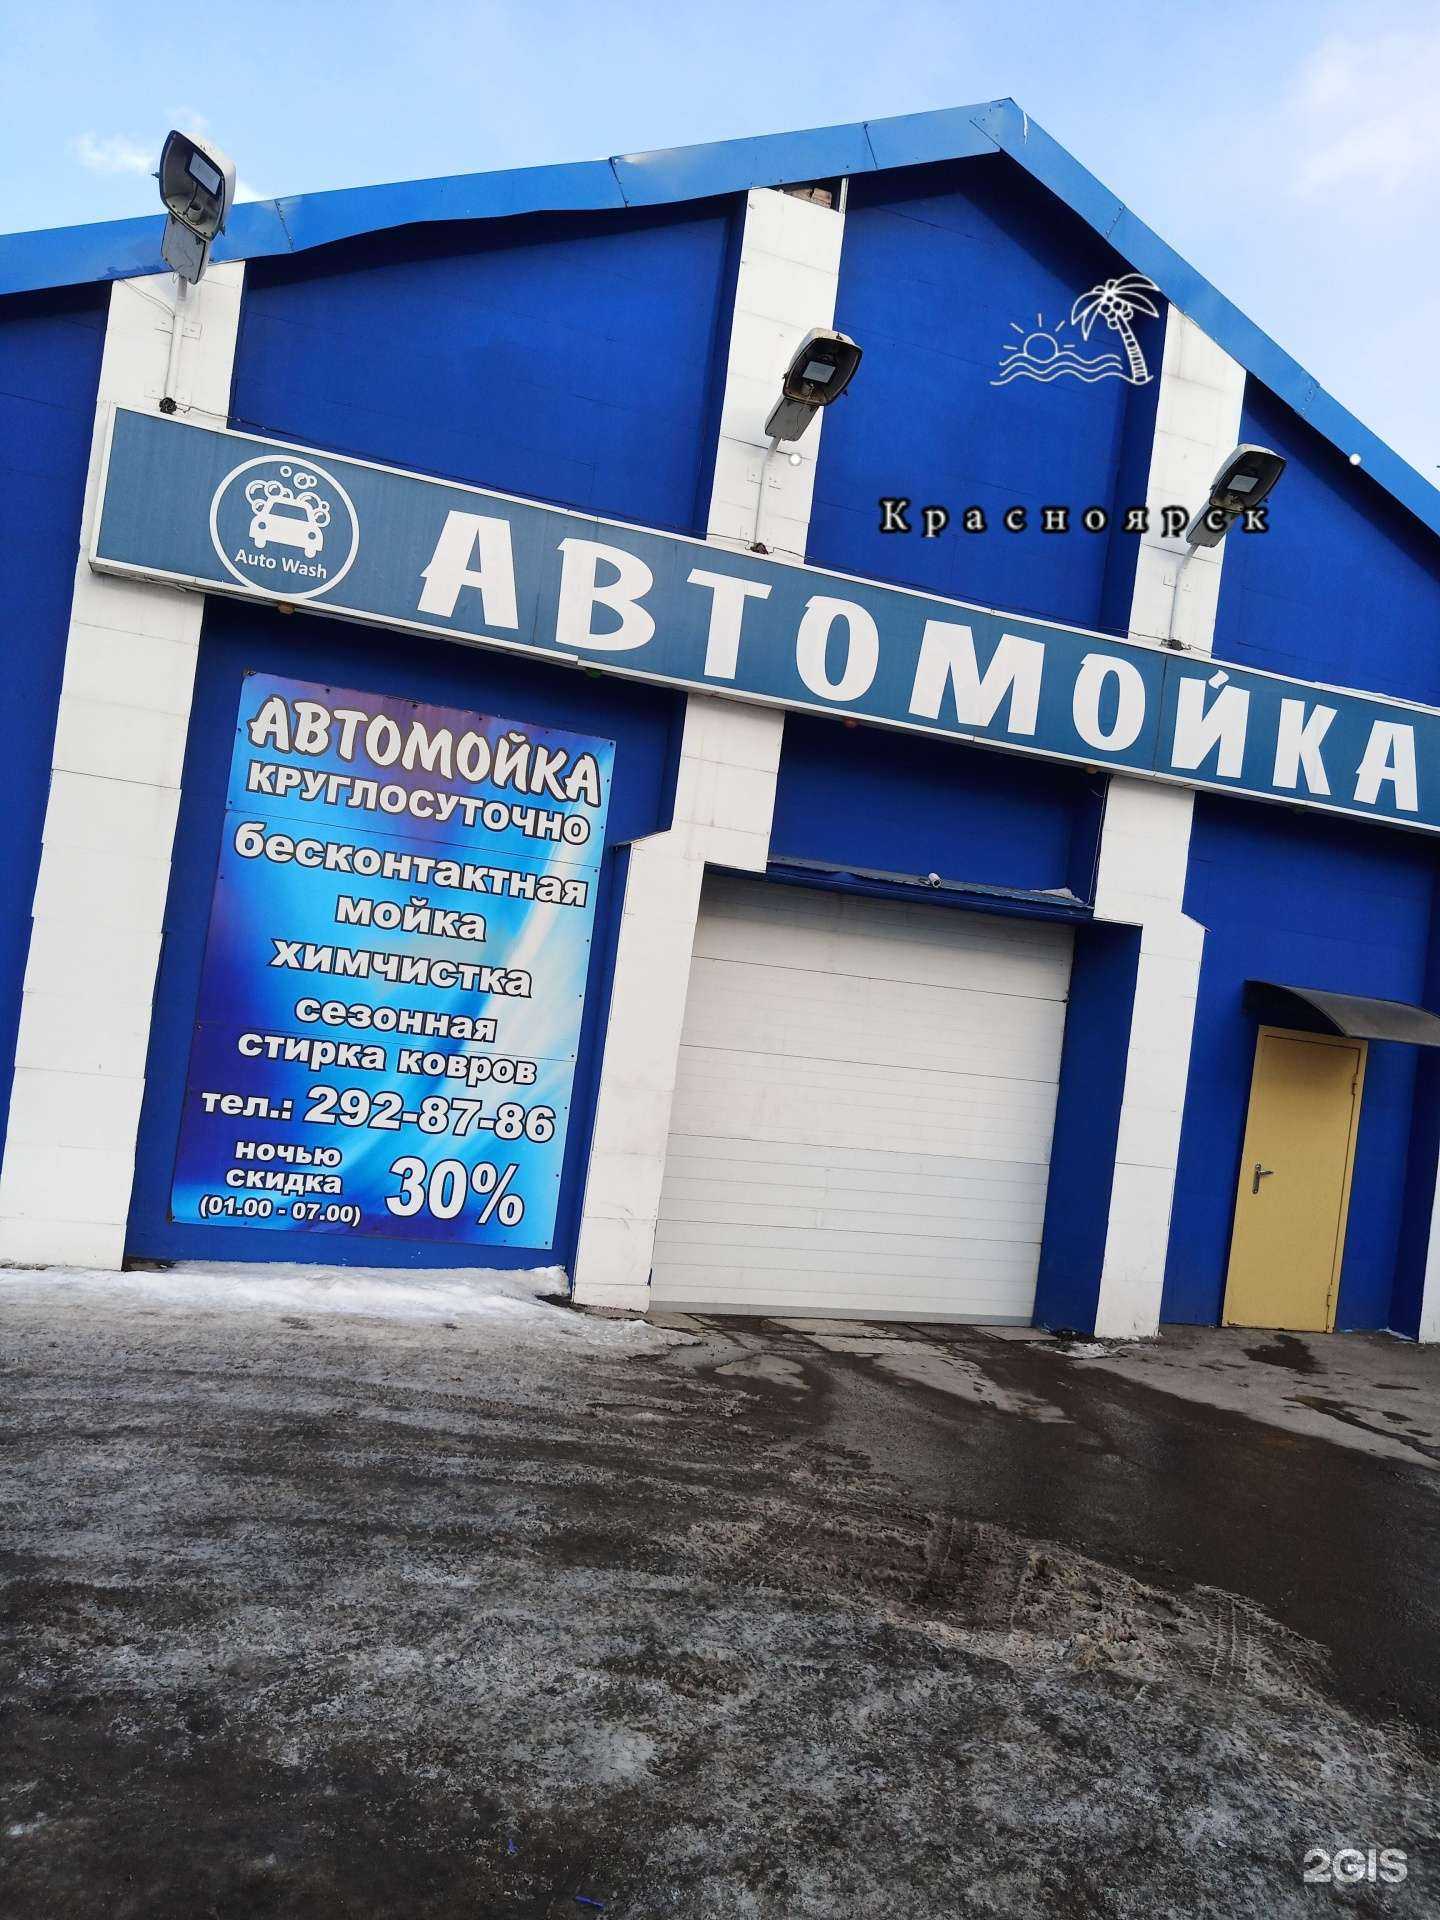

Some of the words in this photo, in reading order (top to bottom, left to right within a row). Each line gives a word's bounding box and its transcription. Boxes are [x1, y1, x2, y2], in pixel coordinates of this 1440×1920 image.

[234, 549, 277, 569] Auto
[282, 556, 327, 579] Wash
[418, 509, 1420, 812] АВТОМОЙКА
[248, 697, 601, 806] АВТОМОЙКА
[246, 761, 590, 845] КРУГЛОСУТОЧНО
[234, 822, 588, 907] бесконтактная
[336, 896, 486, 942] мойка
[269, 939, 531, 998] химчистка
[295, 997, 497, 1042] сезонная
[238, 1032, 386, 1071] стирка
[398, 1049, 537, 1087] ковров
[202, 1091, 292, 1119] тел.:
[303, 1085, 555, 1144] 292-87-86
[235, 1139, 342, 1167] ночью
[226, 1169, 342, 1195] скидка
[385, 1156, 524, 1226] 30%
[199, 1196, 272, 1219] (01.00
[292, 1200, 361, 1226] 07.00)
